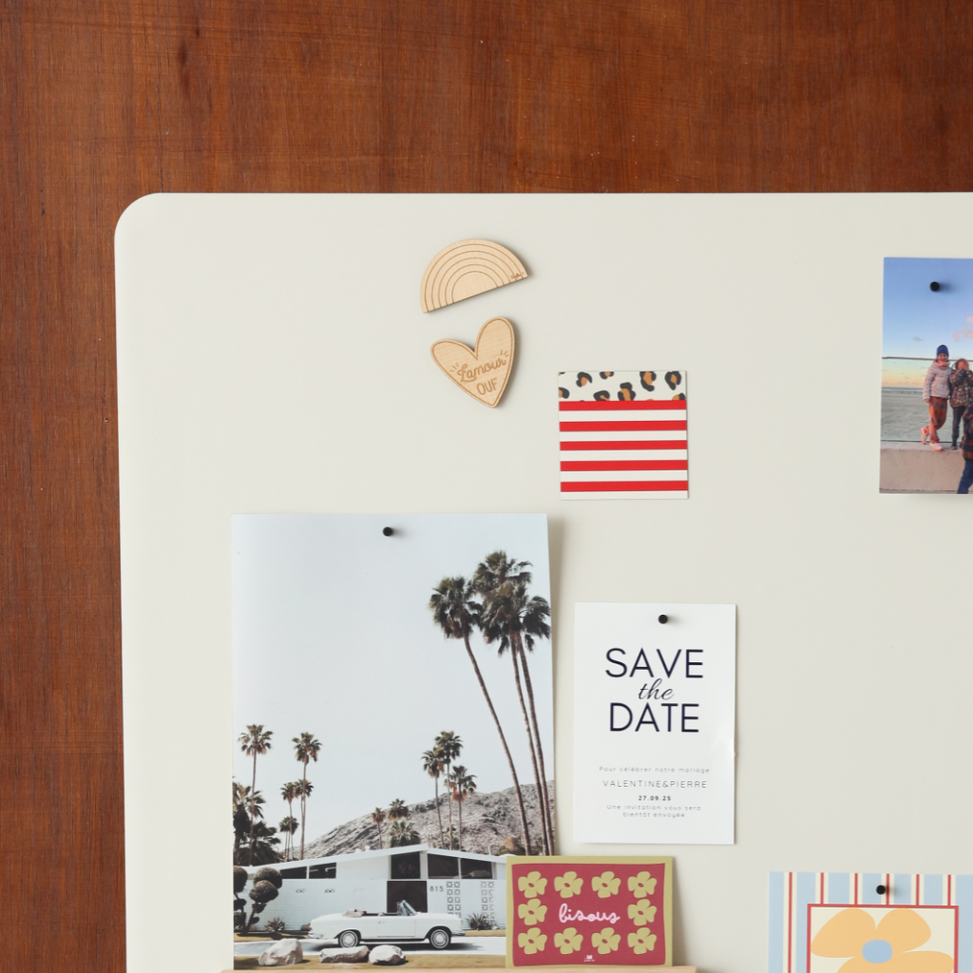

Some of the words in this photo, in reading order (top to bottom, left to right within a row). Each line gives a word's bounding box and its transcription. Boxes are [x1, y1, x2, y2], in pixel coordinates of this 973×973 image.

[476, 377, 498, 395] OUF
[605, 647, 704, 678] SAVE
[638, 678, 675, 700] the
[610, 702, 700, 733] DATE
[559, 903, 620, 924] bisous
